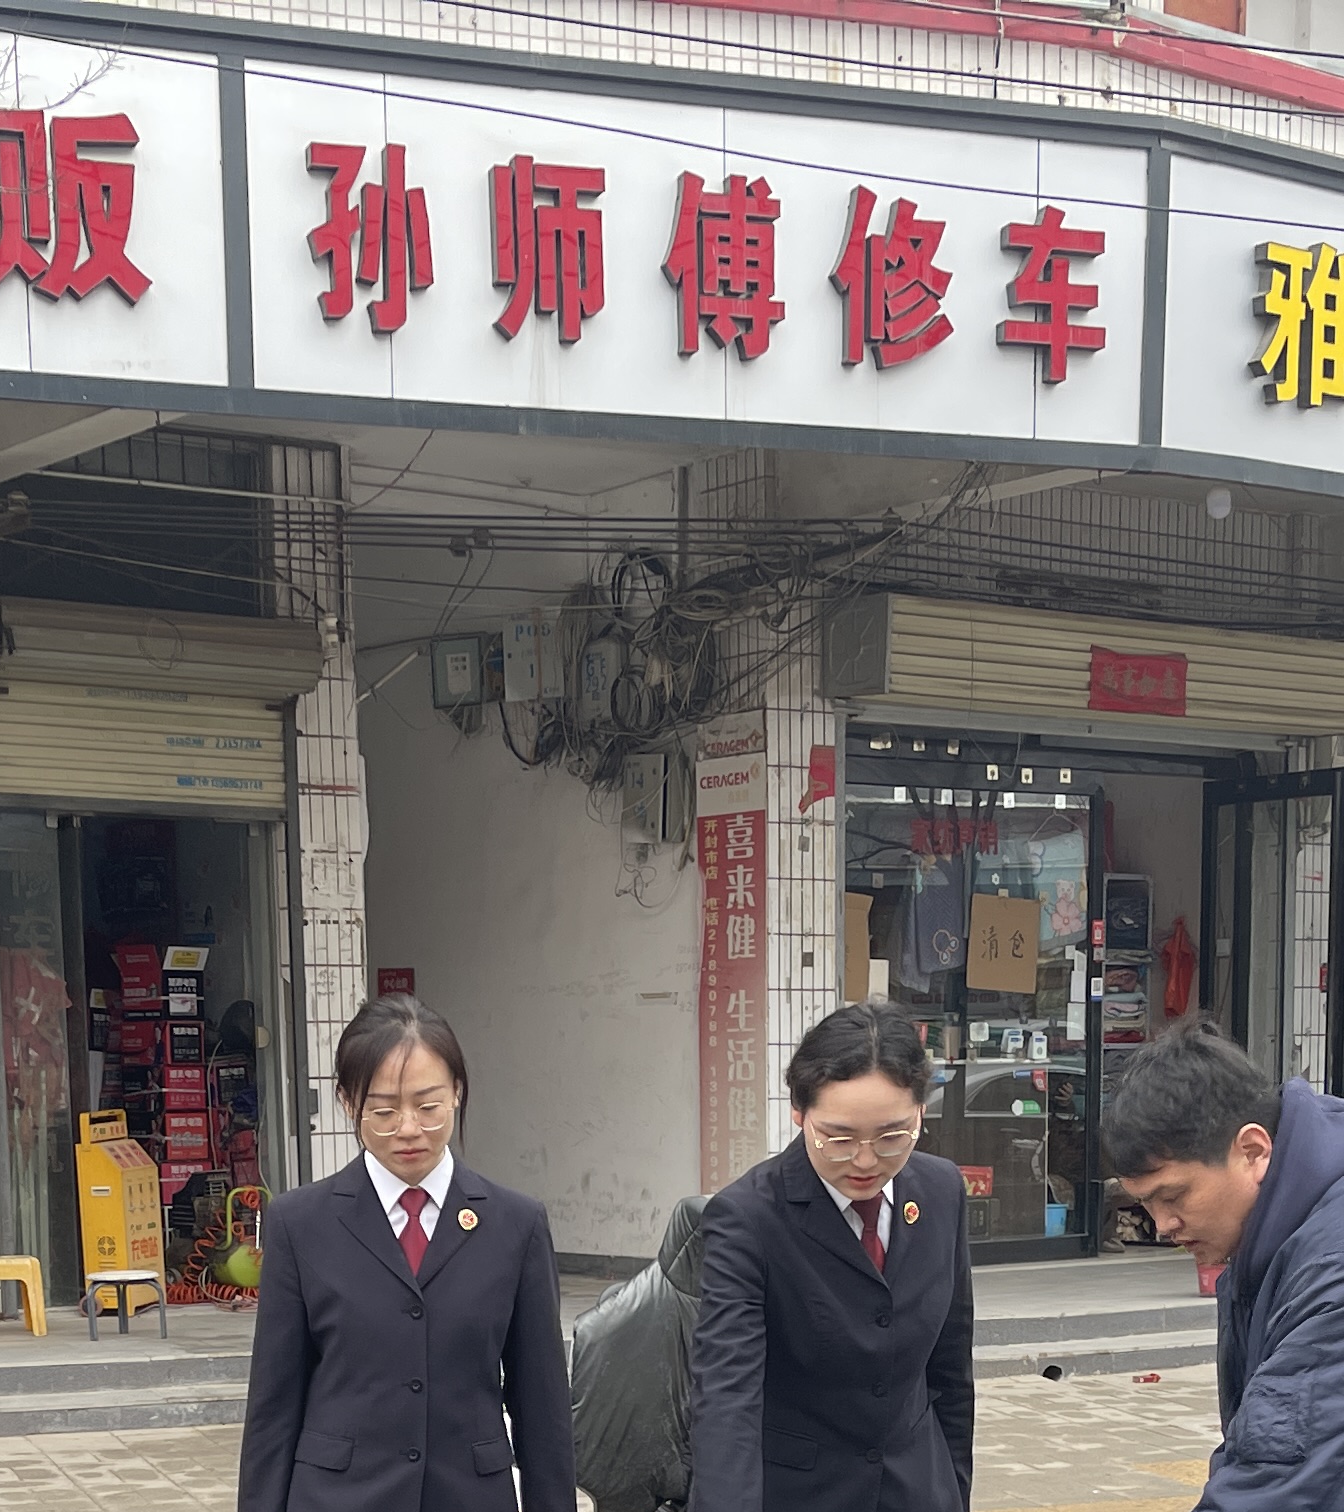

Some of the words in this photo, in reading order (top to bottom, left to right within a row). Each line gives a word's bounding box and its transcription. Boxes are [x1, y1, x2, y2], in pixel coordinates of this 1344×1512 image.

[307, 143, 1107, 385] 孙师傅修车
[700, 771, 750, 790] CERAGEM
[704, 819, 719, 880] 开封市店
[724, 814, 756, 960] 喜来健
[725, 989, 759, 1178] 生活健康
